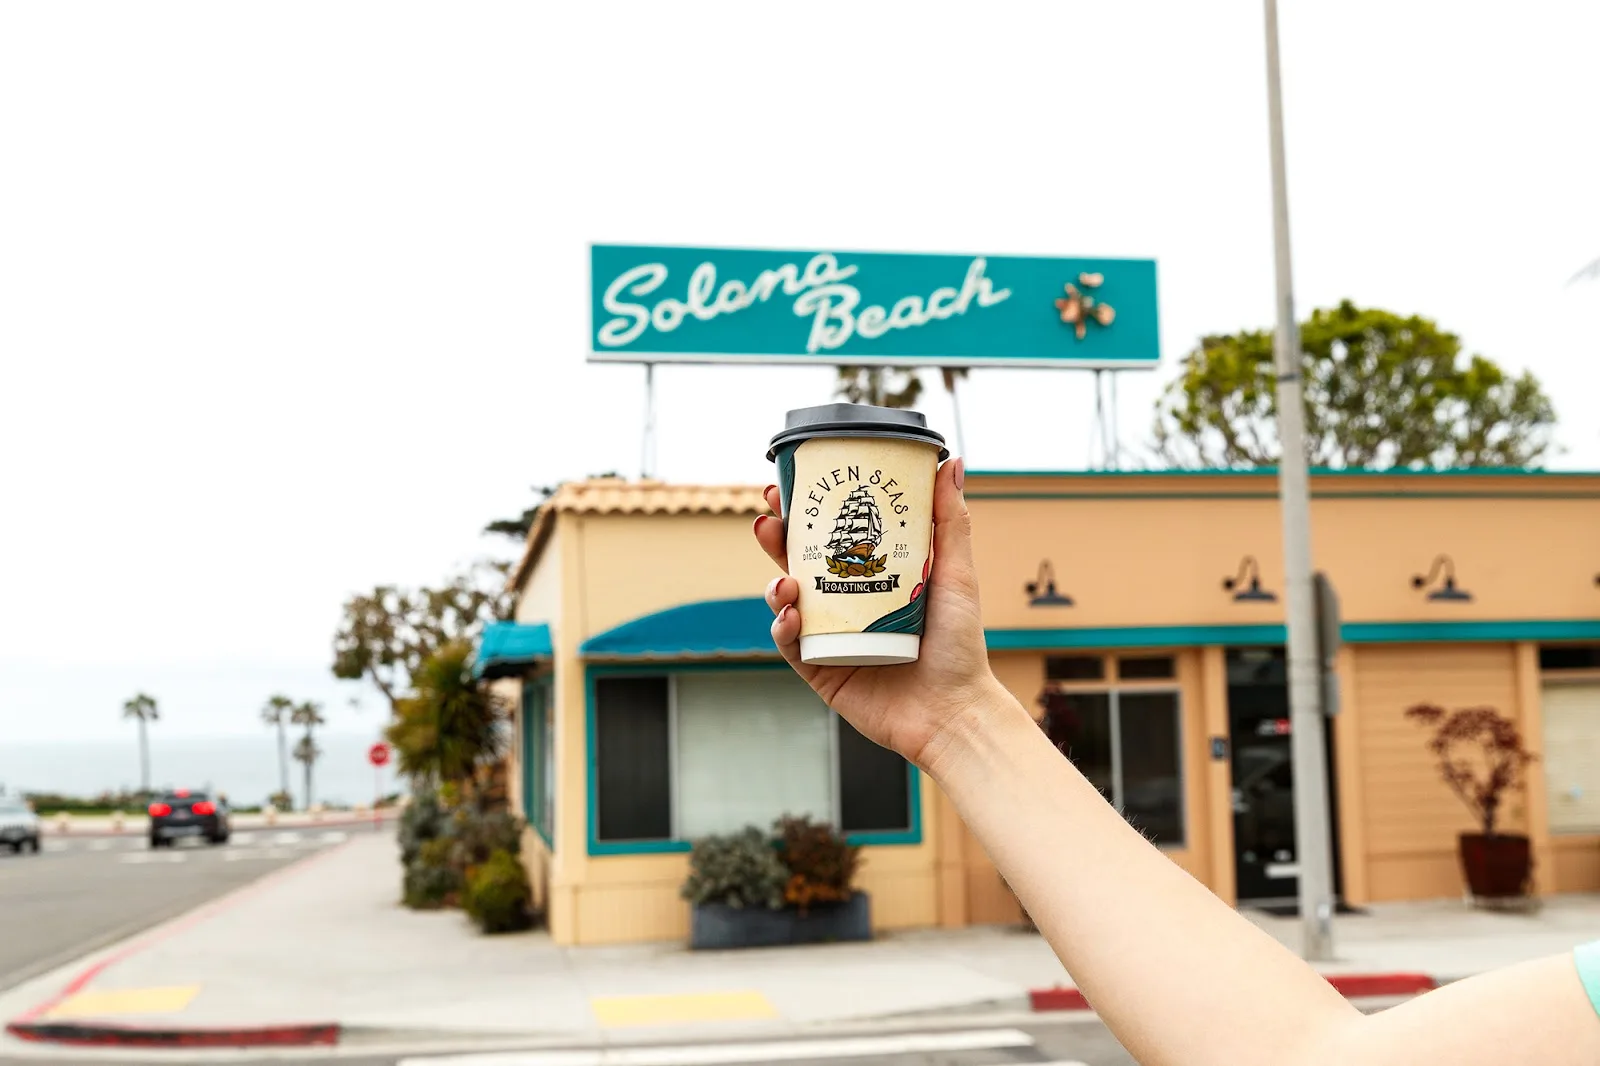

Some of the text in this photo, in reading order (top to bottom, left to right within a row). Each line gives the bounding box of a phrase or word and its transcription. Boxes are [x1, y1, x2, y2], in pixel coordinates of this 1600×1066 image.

[598, 253, 858, 347] Solana
[794, 257, 1011, 353] Beach
[805, 466, 909, 517] SEVEN SEAS
[804, 545, 818, 553] SAN
[895, 543, 907, 551] EST
[803, 552, 823, 561] DIEGO
[893, 551, 909, 559] 2017
[824, 582, 871, 593] ROASTING
